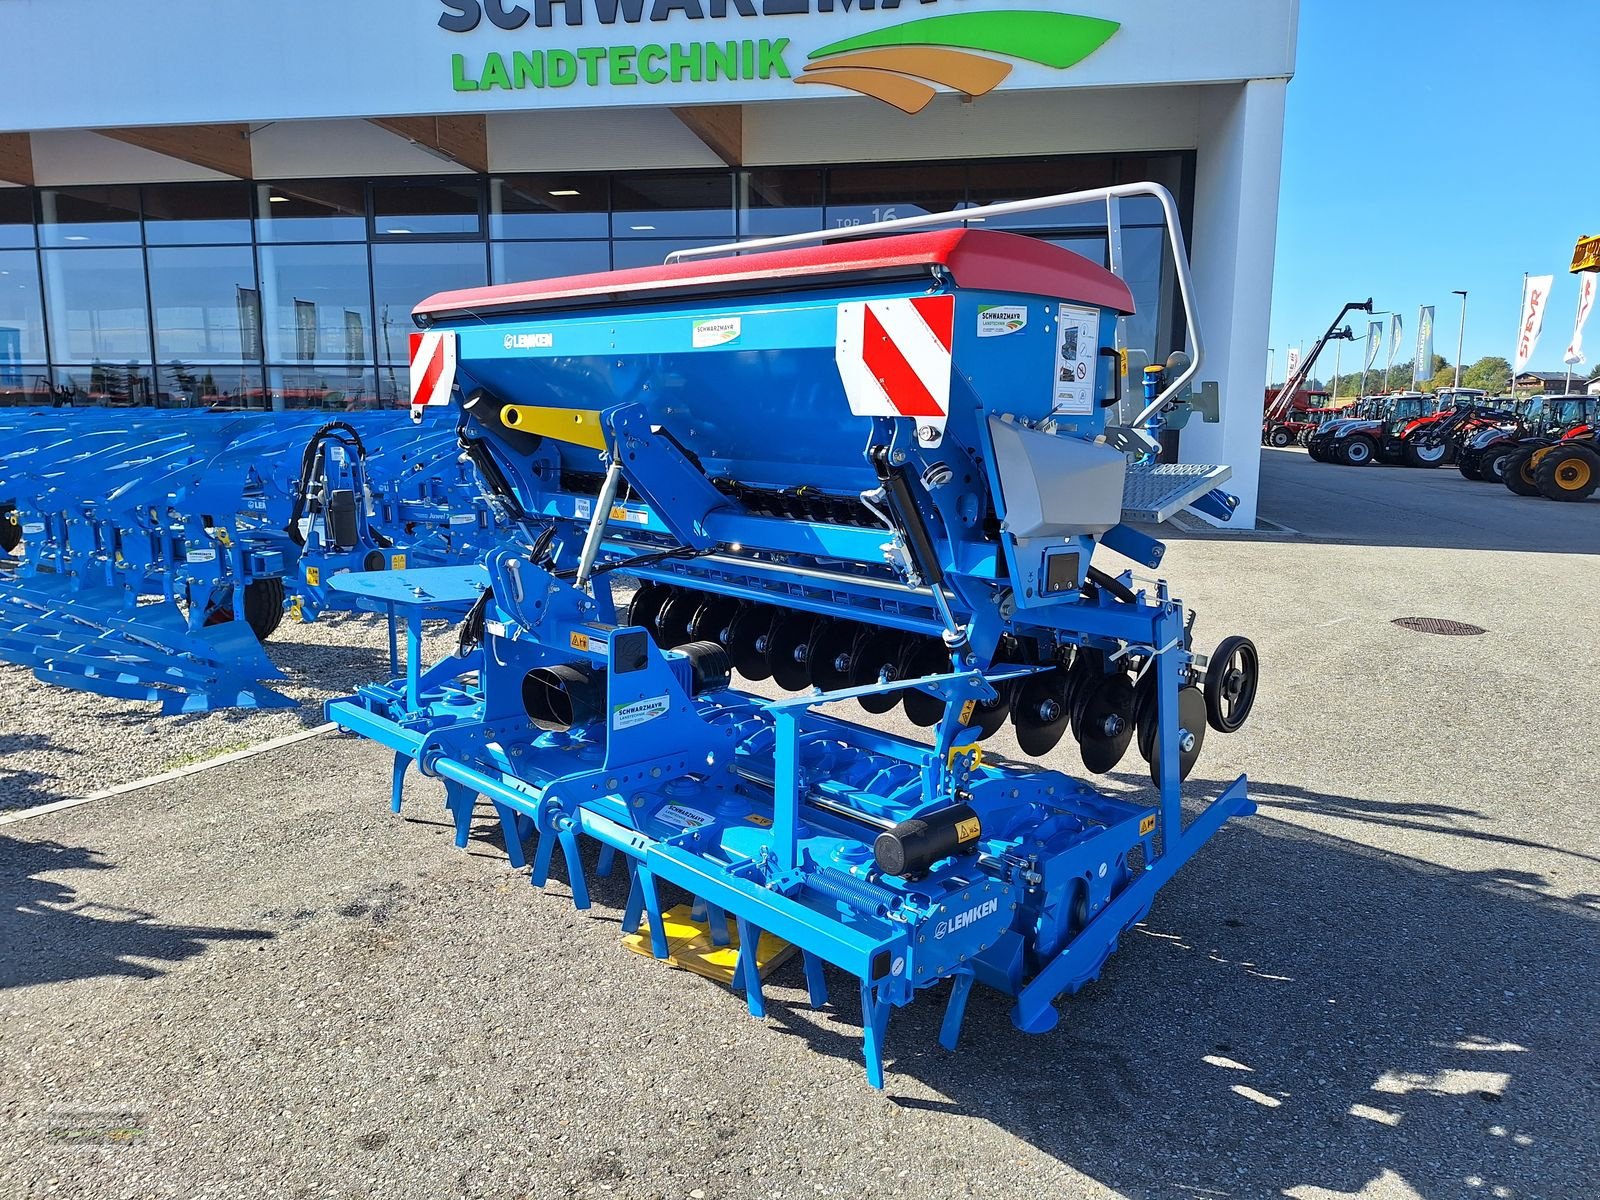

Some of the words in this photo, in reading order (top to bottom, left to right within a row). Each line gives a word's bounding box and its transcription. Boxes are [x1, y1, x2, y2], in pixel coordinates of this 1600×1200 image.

[452, 38, 791, 91] LANDTECHNIK
[836, 218, 860, 228] TOR
[872, 207, 897, 223] 16
[982, 312, 1021, 320] SCHWARZMAYR
[1519, 289, 1542, 358] STEYR
[697, 324, 734, 333] SCHWARZMAYR
[513, 333, 553, 350] LEMKEN
[428, 512, 446, 520] Juwel
[618, 702, 662, 716] SCHWARZMAYR
[668, 804, 705, 823] SCHWARZMAYR
[948, 897, 998, 934] LEMKEN
